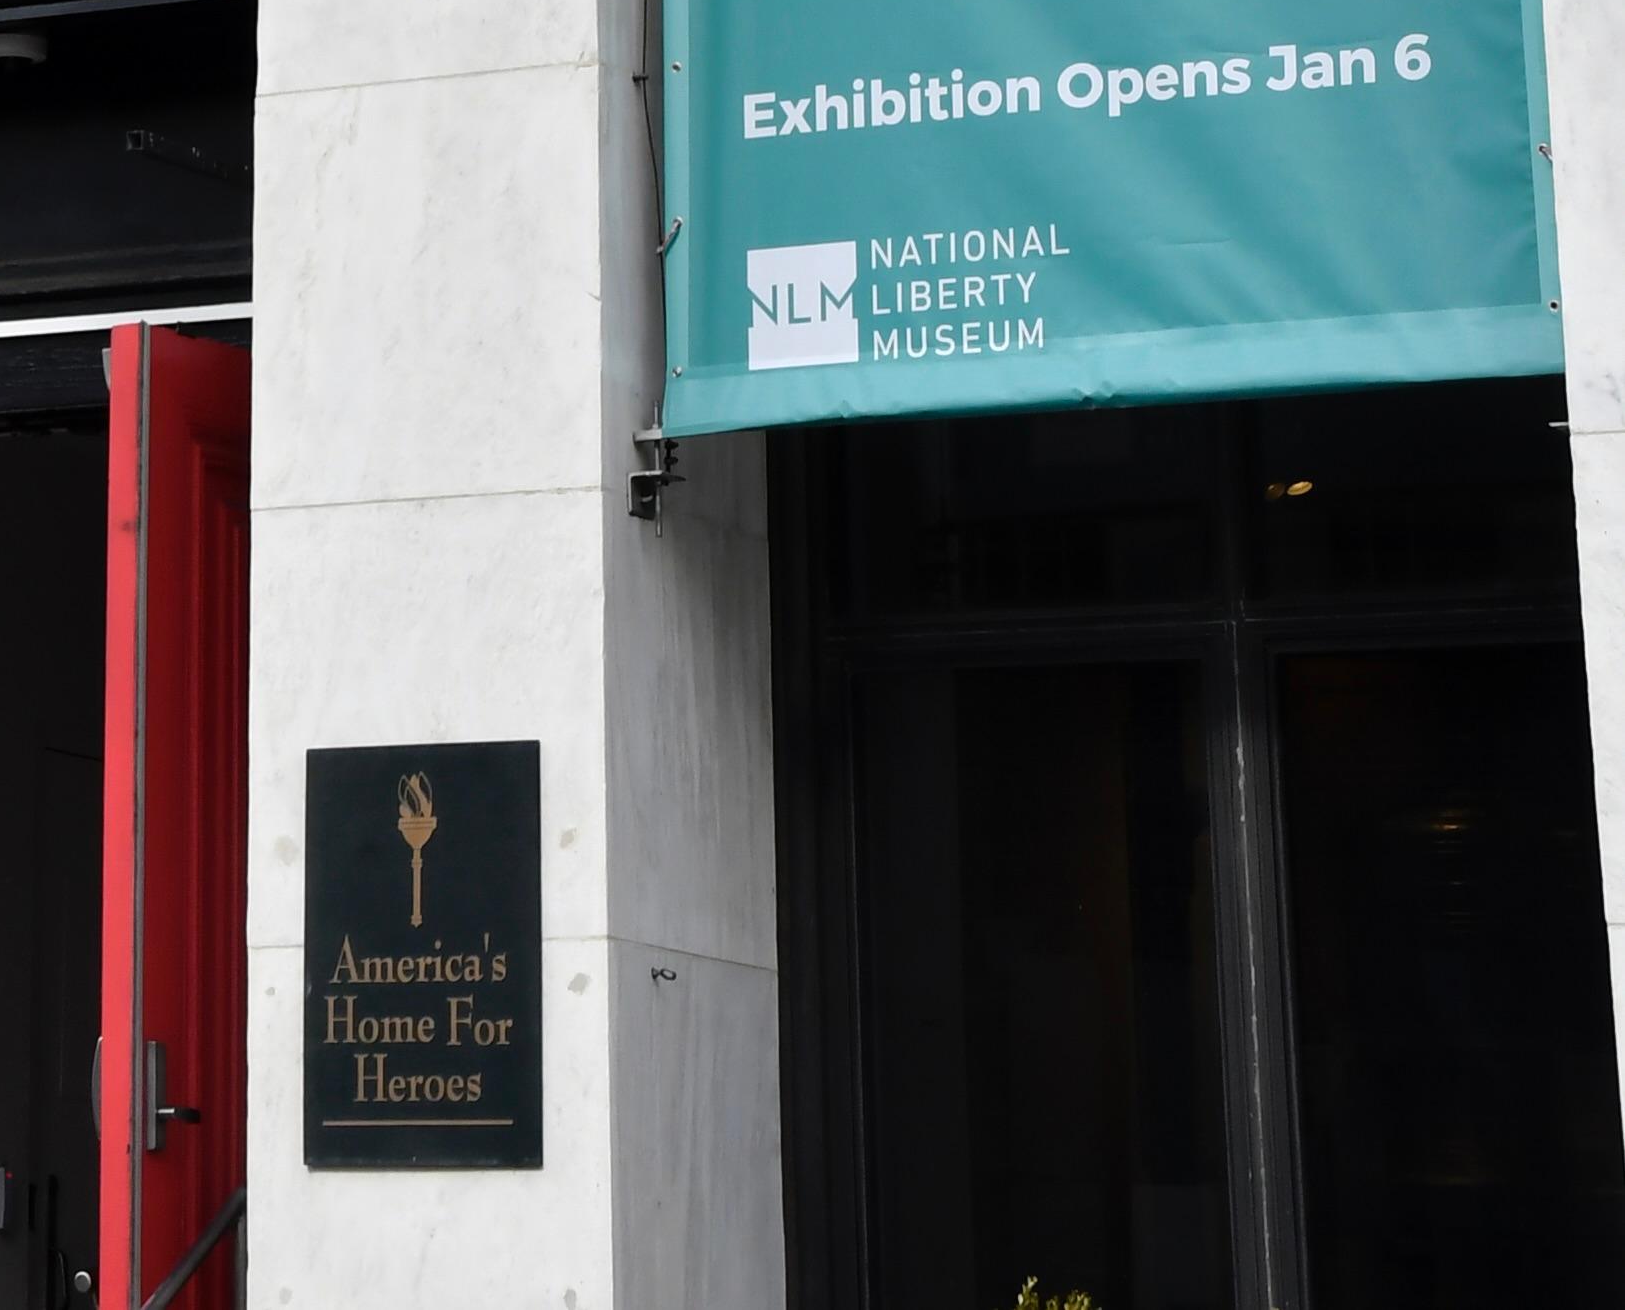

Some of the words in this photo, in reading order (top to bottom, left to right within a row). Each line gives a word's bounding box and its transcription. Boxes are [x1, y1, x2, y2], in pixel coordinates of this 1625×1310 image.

[743, 69, 1041, 139] Exhibition
[1057, 51, 1250, 118] Opens
[1266, 43, 1375, 91] Jan
[1394, 34, 1431, 81] 6
[871, 224, 1070, 269] NATIONAL
[747, 279, 853, 326] NLM
[872, 272, 1036, 315] LIBERTY
[874, 317, 1044, 360] MUSEUM
[329, 932, 507, 985] America's
[323, 995, 434, 1044] Home
[447, 994, 513, 1046] For
[354, 1053, 482, 1103] Heroes
